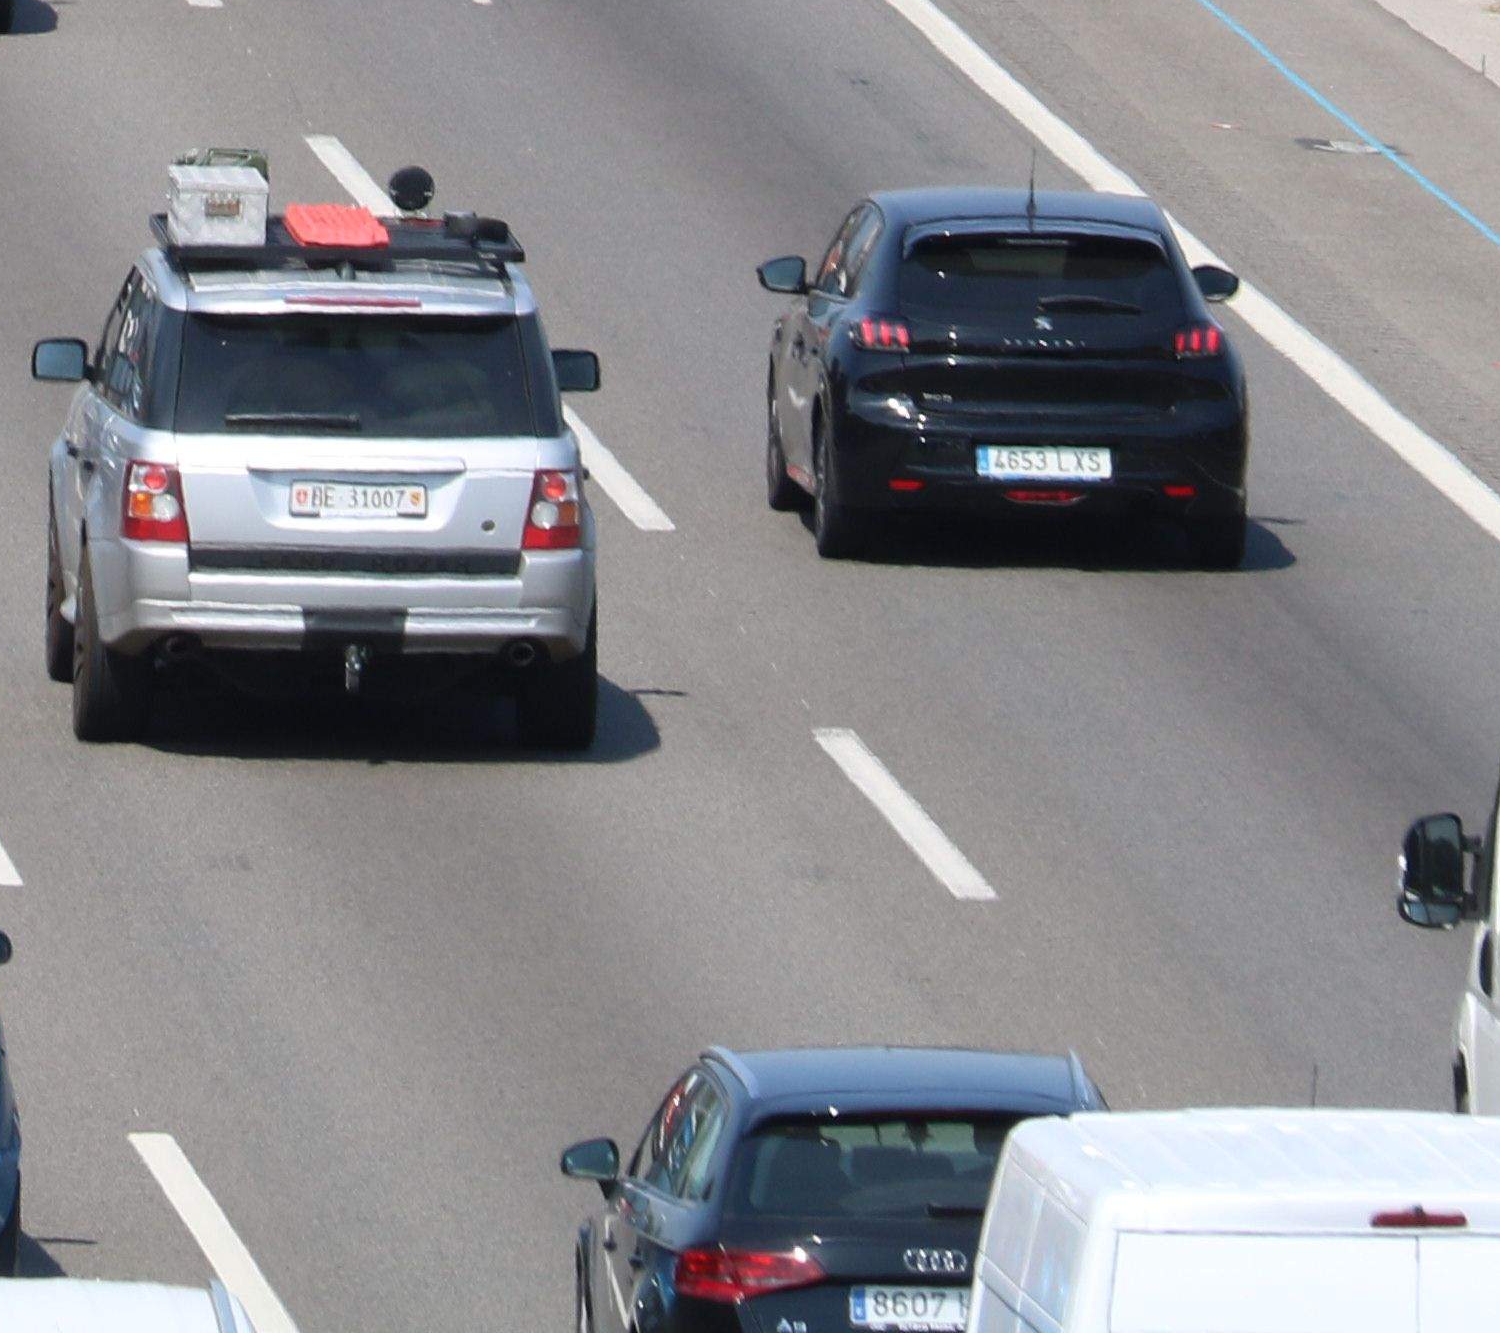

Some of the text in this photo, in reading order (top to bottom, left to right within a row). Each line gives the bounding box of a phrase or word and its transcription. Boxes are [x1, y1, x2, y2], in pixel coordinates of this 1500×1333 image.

[993, 450, 1103, 473] 4653 LXS
[872, 1291, 948, 1318] 8607
